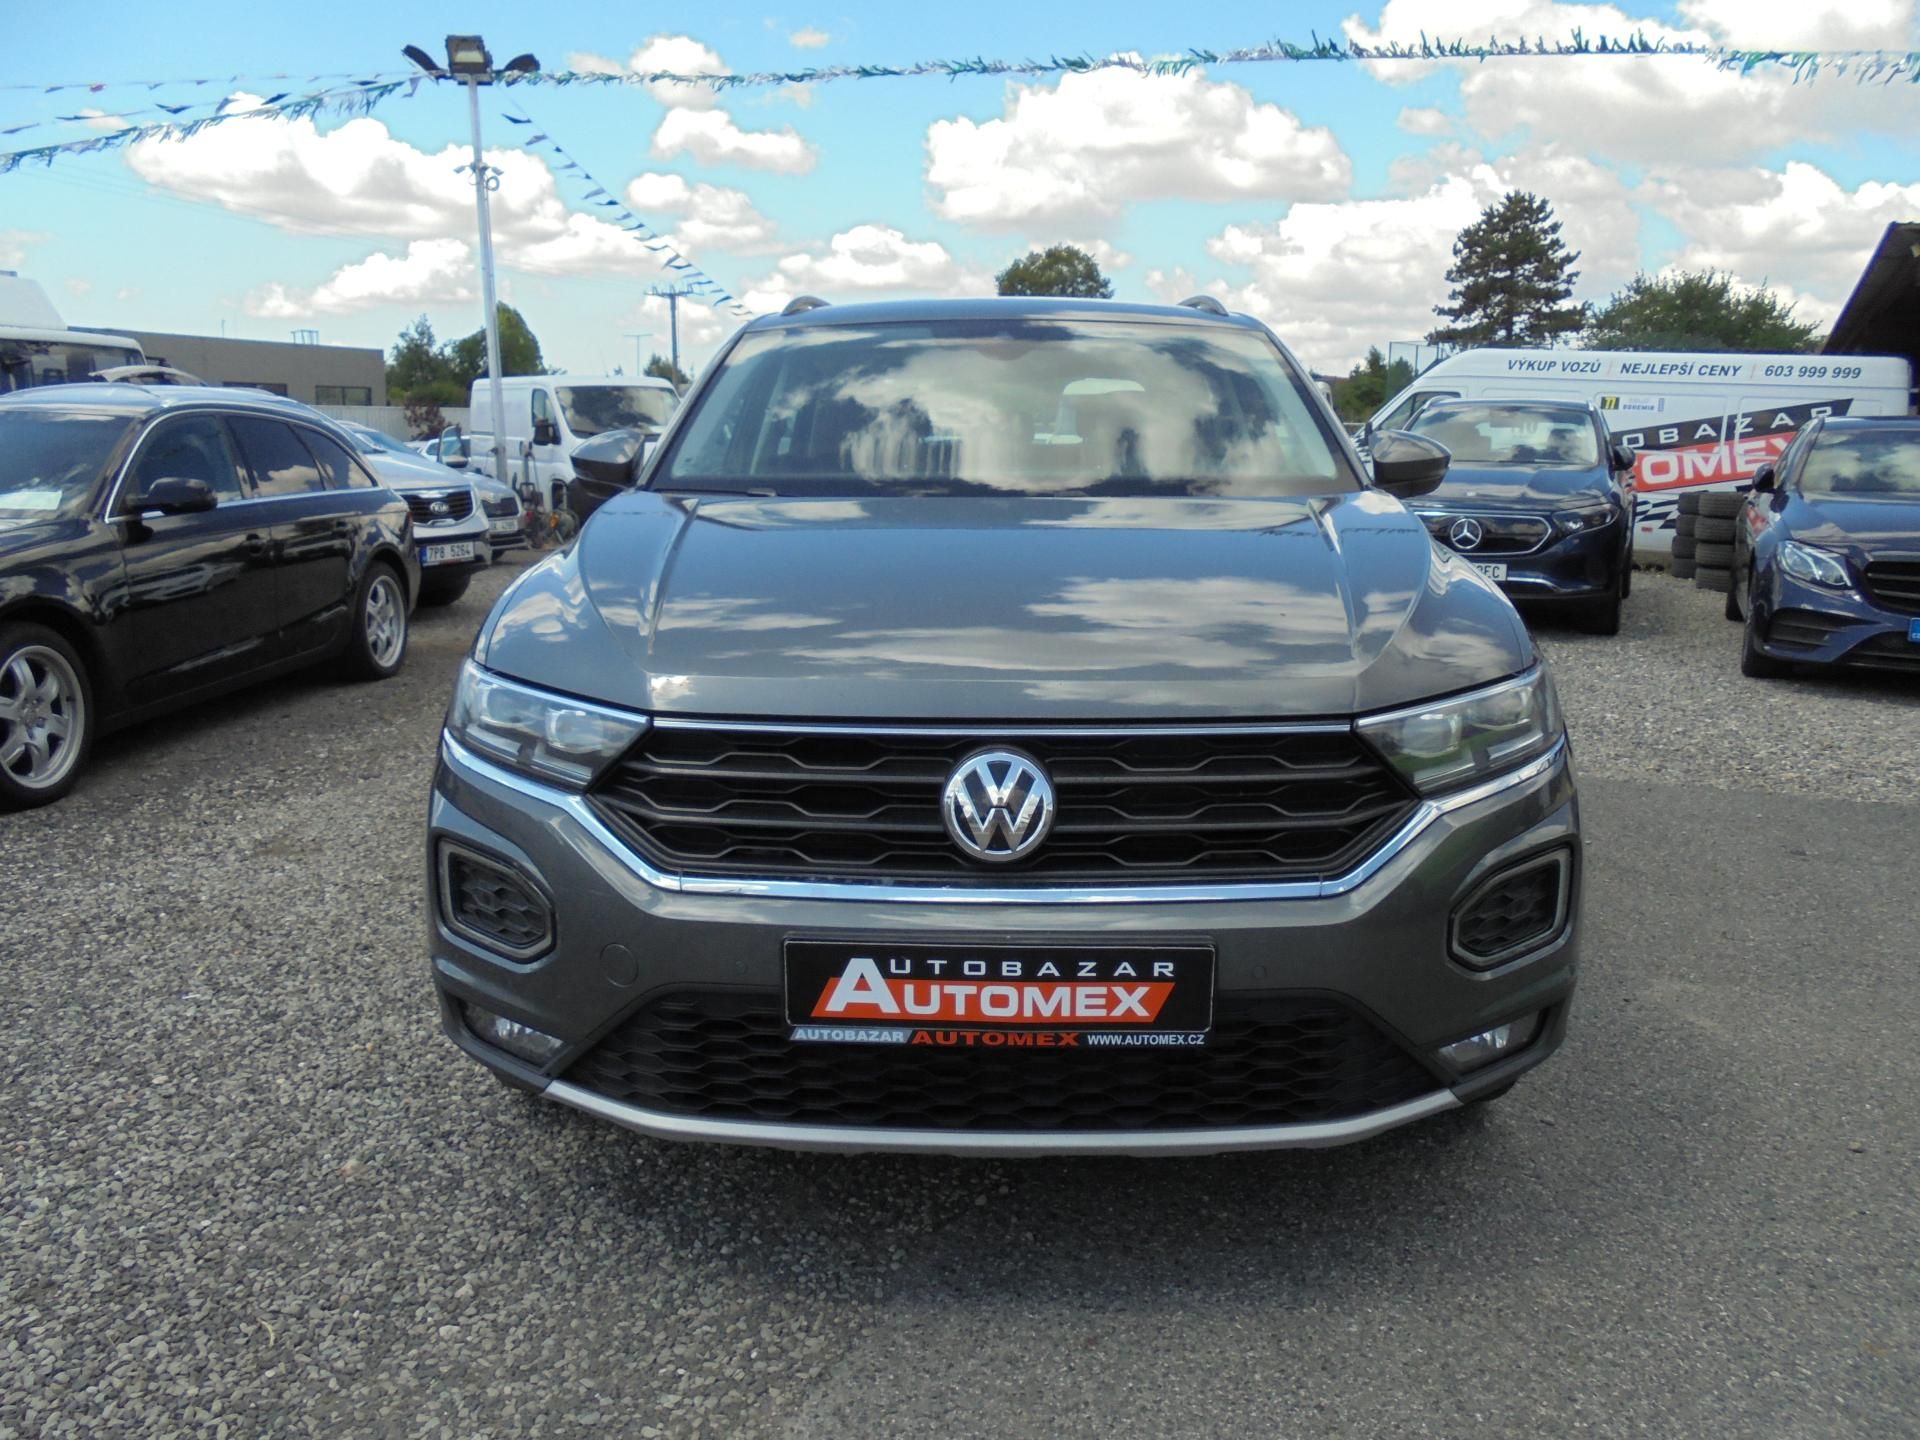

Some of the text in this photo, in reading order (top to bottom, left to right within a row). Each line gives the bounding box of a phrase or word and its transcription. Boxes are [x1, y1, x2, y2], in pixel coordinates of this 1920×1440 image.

[1698, 365, 1742, 377] CENY
[1764, 364, 1862, 380] 603 999 999
[1622, 406, 1833, 448] OBAZAR
[824, 957, 1151, 1018] AUTOMEX
[795, 1029, 1205, 1046] AUTOBAZAR AUTOMEX WWW.AUTOMEX.CZ
